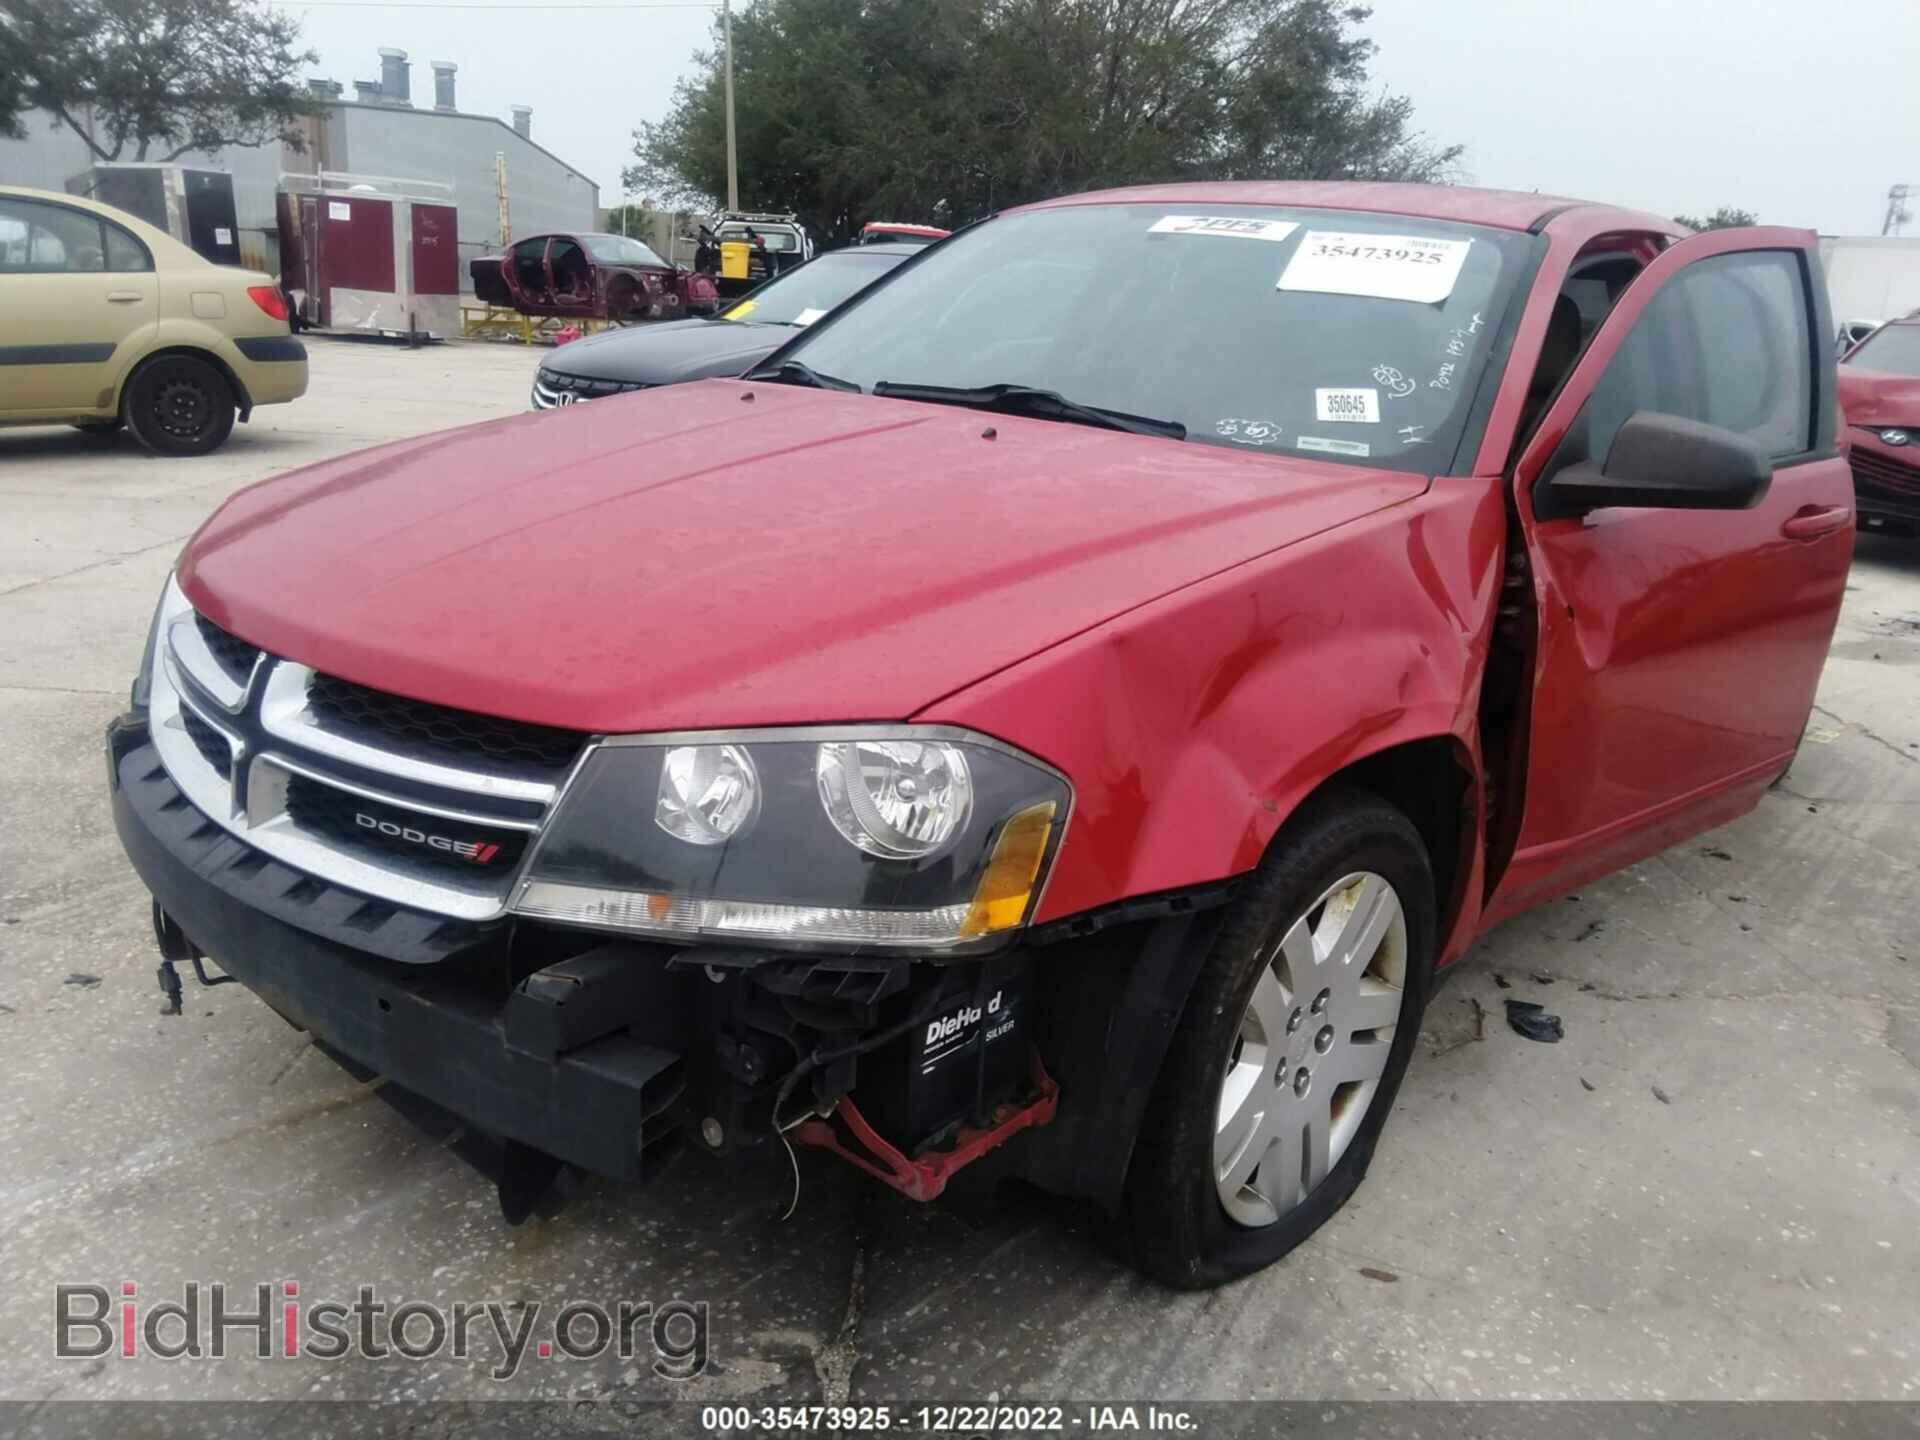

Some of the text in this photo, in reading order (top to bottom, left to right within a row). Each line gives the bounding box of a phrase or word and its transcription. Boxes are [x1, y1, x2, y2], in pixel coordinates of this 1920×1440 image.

[1311, 244, 1444, 265] 35473925
[1327, 395, 1366, 414] 350645
[355, 812, 479, 858] DODGE
[926, 990, 1003, 1045] DieHad
[985, 1019, 1016, 1042] SILVER
